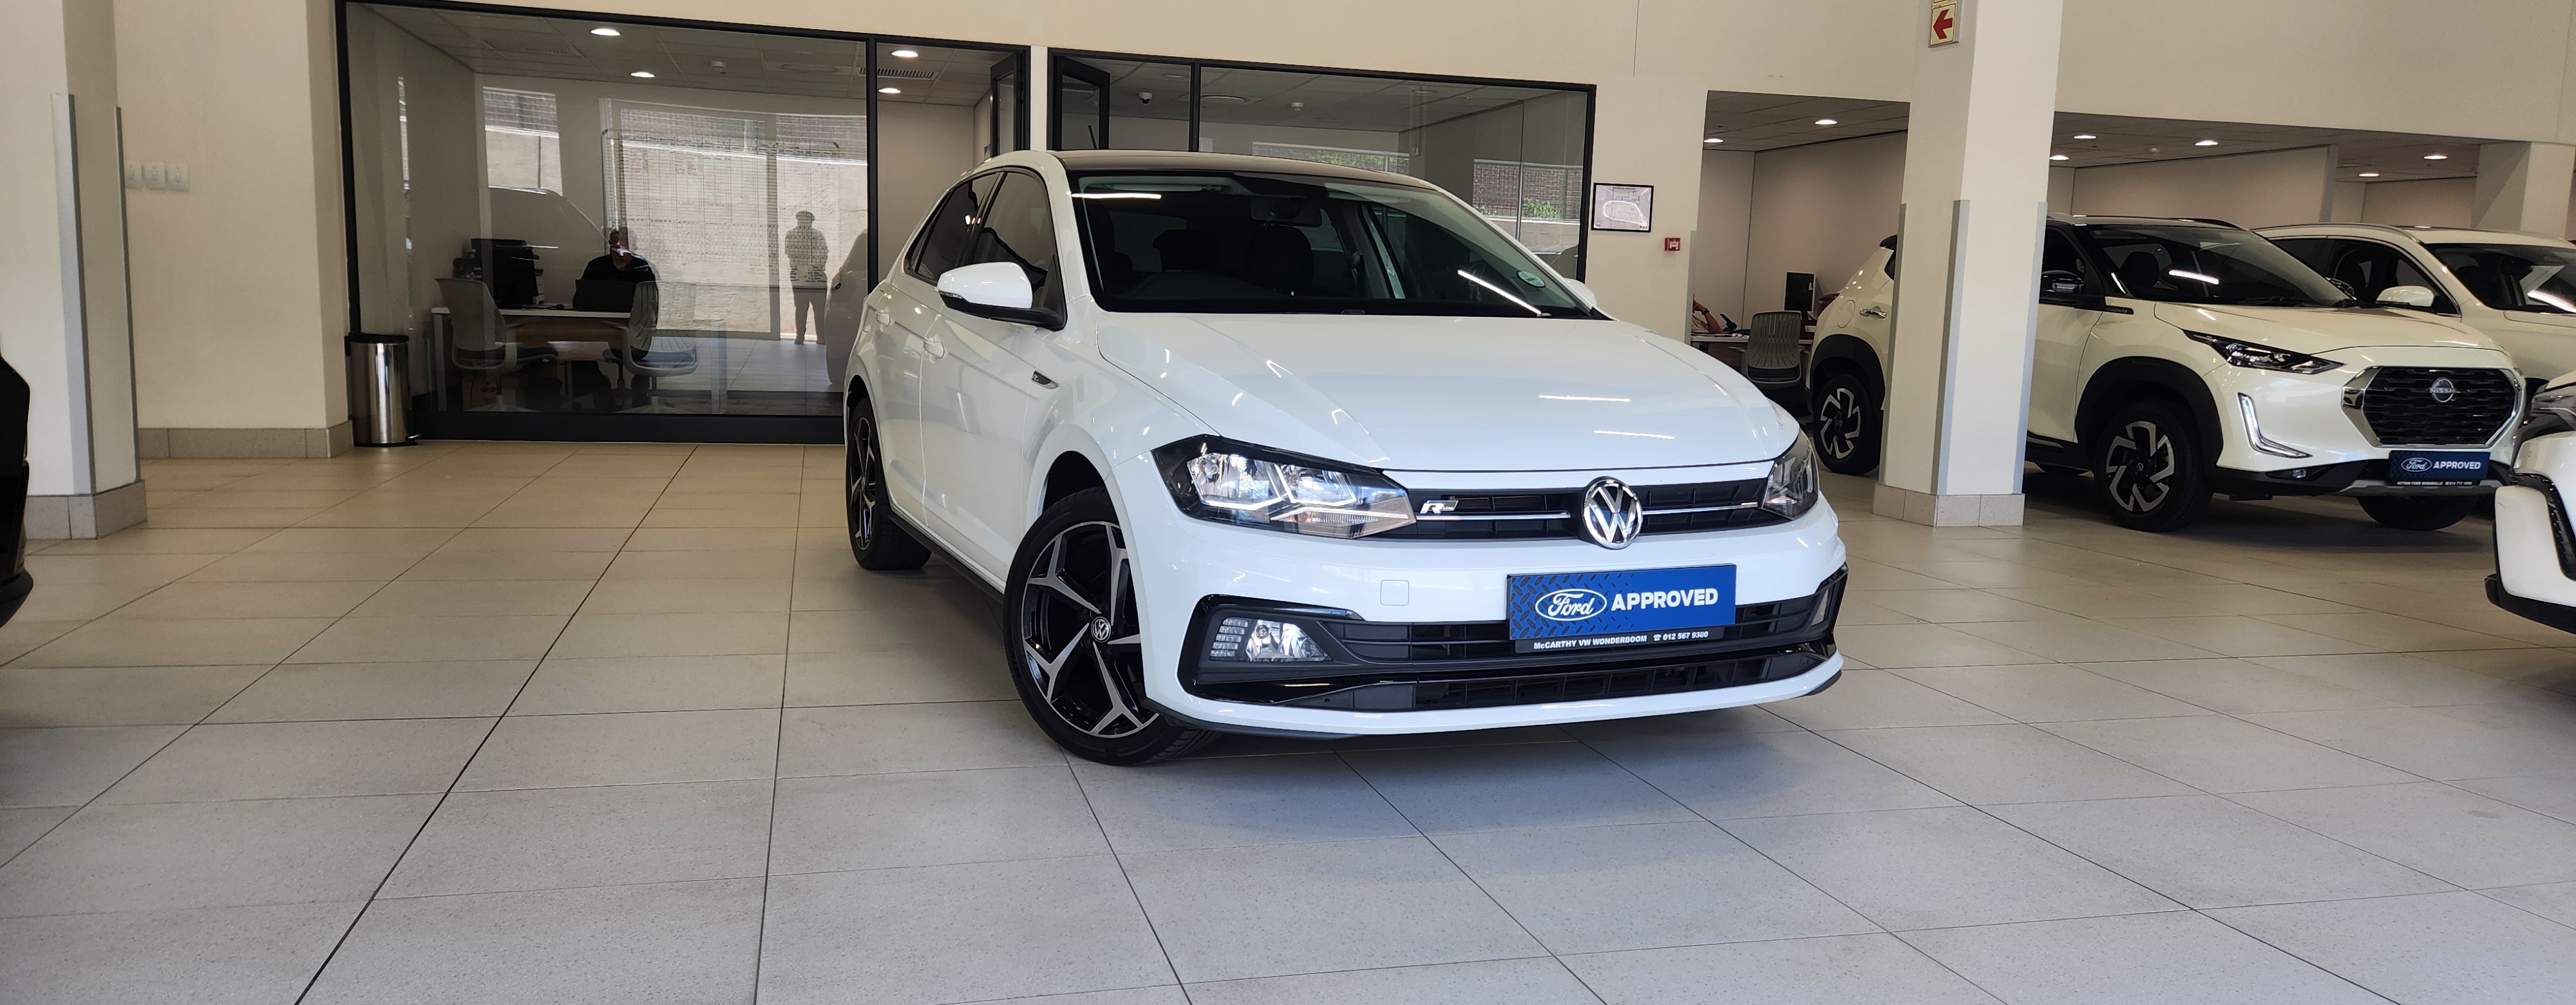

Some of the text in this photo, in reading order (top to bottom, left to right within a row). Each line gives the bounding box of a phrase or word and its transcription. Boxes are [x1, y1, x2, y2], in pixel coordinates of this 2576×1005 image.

[2405, 459, 2481, 470] Ford APPROVED
[1548, 588, 1719, 617] Ford APPROVED
[1533, 640, 1577, 649] McCARTHY
[1593, 635, 1647, 646] WONDERBOOM
